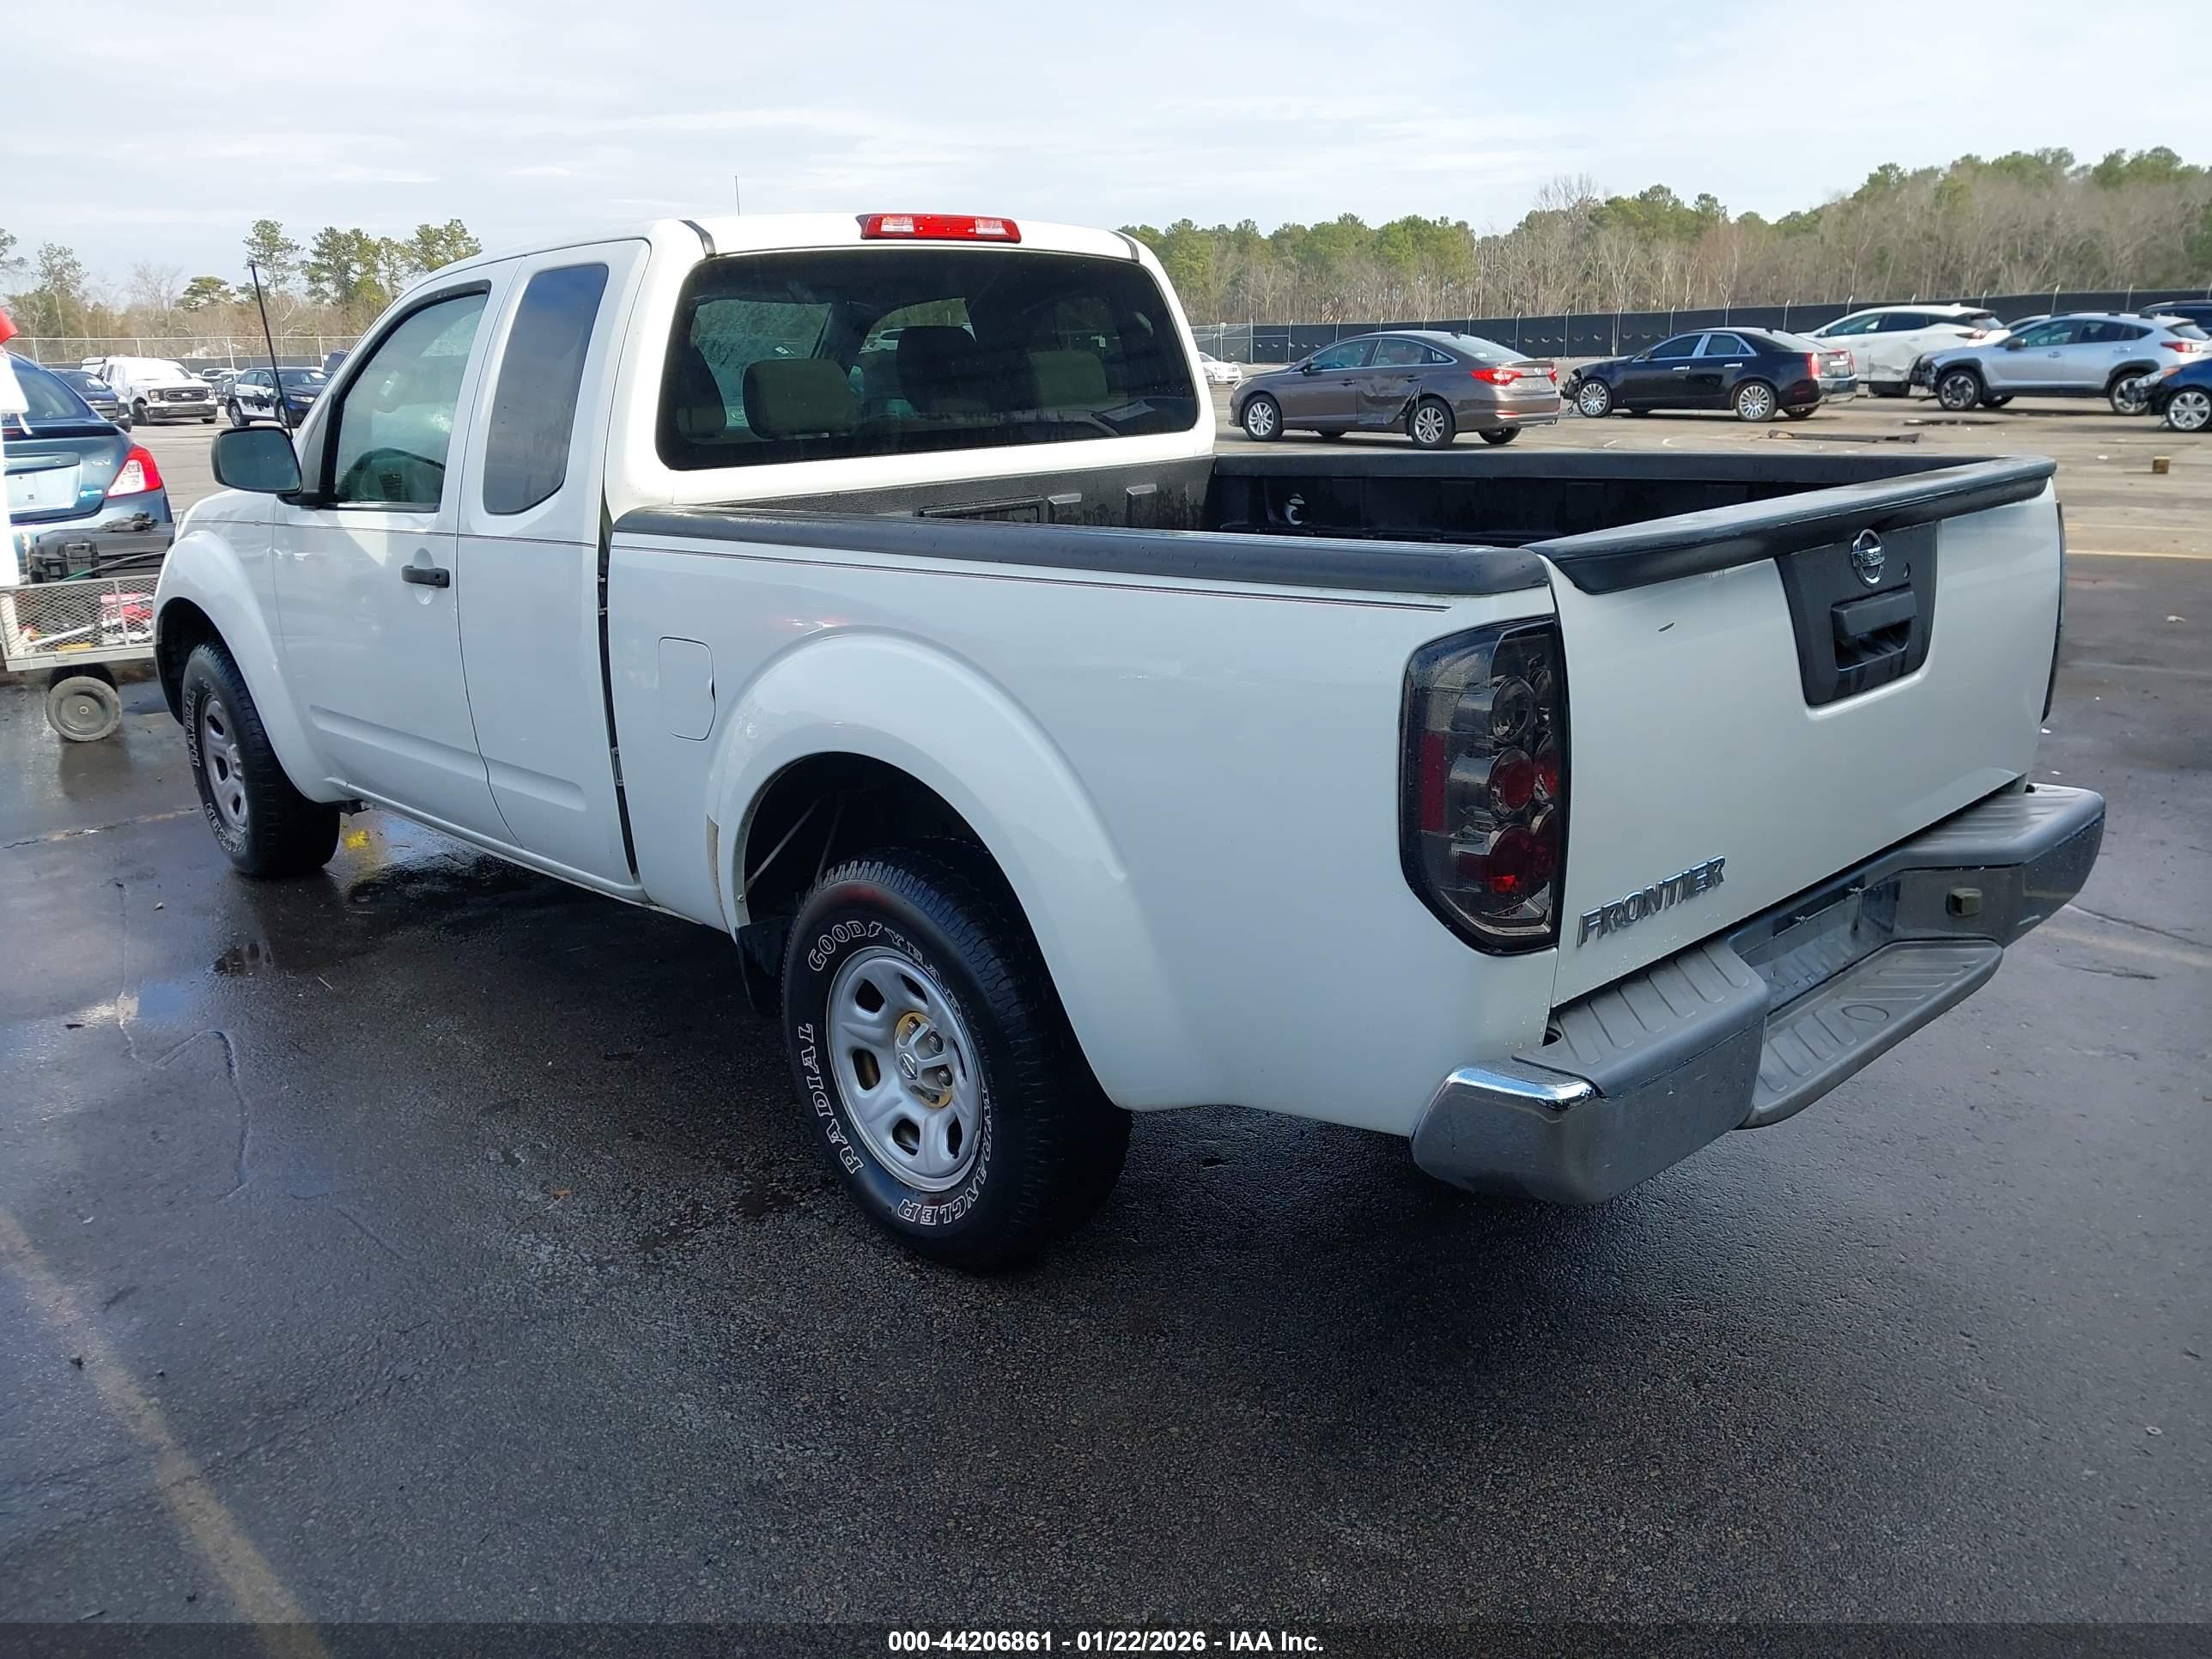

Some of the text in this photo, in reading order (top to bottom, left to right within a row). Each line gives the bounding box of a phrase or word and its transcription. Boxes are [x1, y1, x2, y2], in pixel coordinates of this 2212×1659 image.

[1577, 855, 1726, 948] FRONTIER
[798, 1023, 865, 1175] RADIAL
[897, 1086, 993, 1226] WRANGLER
